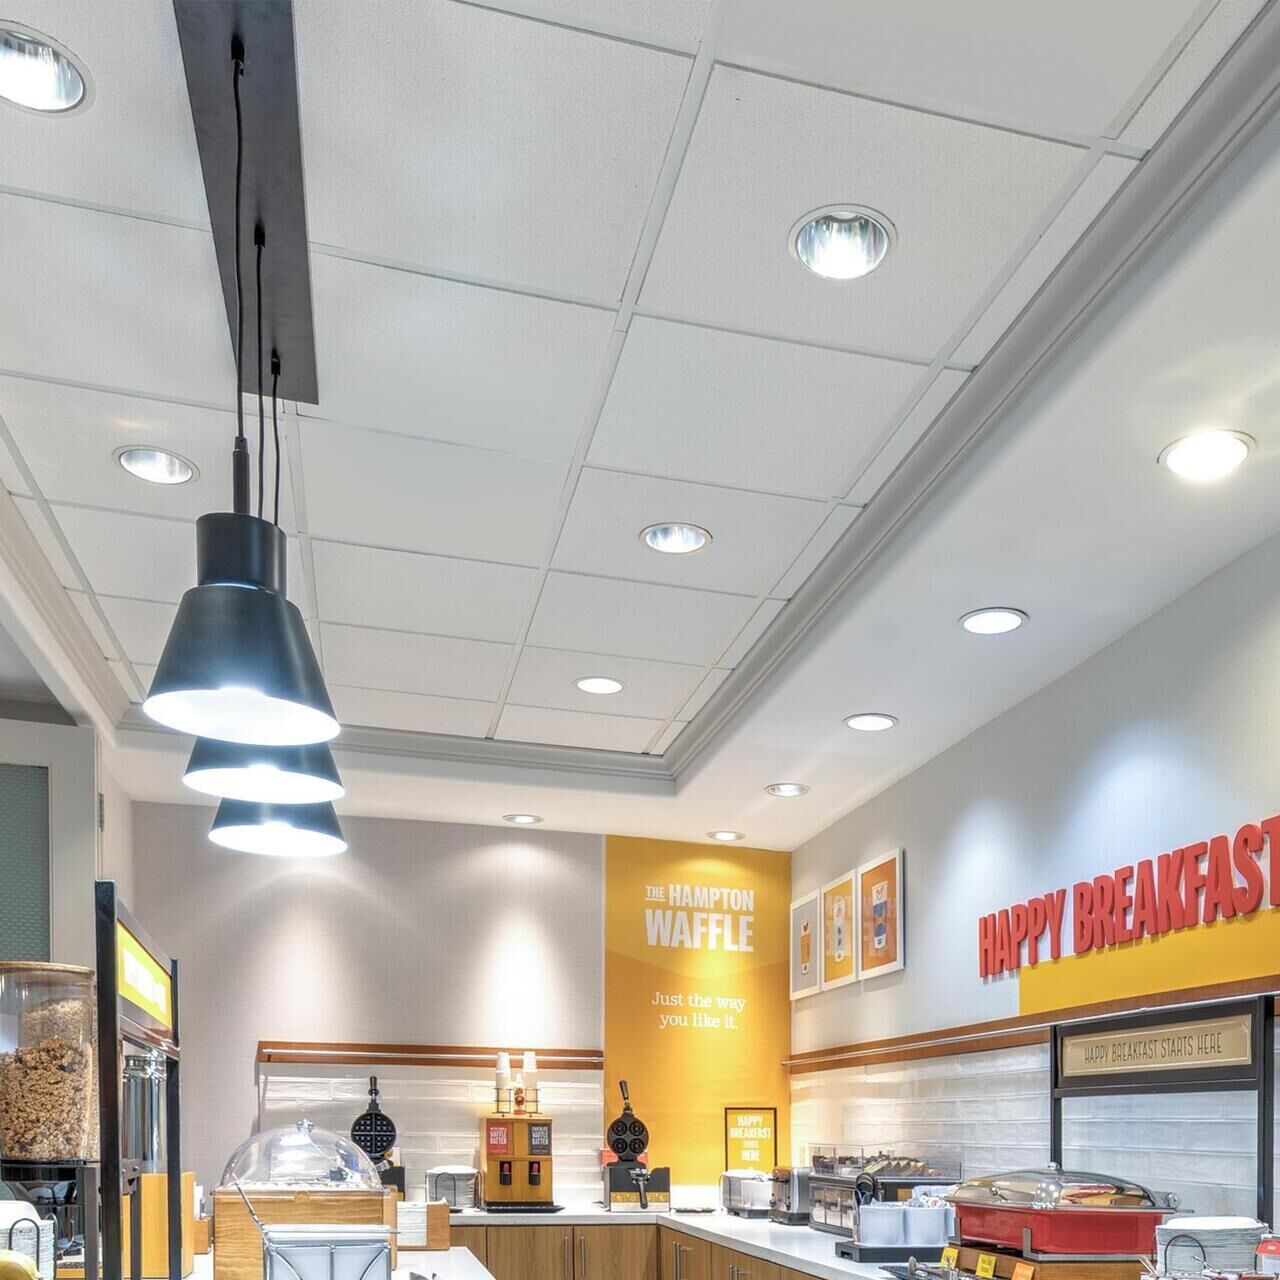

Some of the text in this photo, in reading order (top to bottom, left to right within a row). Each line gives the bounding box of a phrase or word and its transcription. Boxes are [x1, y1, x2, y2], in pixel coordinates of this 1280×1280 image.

[645, 884, 754, 912] THE HAMPTON
[645, 909, 754, 952] WAFFLE
[978, 888, 1066, 978] HAPPY
[652, 992, 746, 1012] Just the way
[659, 1013, 738, 1029] you like it.
[1084, 1032, 1223, 1065] HAPPY BREAKFAST STARTS HERE
[737, 1115, 764, 1126] HAPPY
[729, 1127, 772, 1138] BREAKFAST
[741, 1149, 760, 1161] HERE
